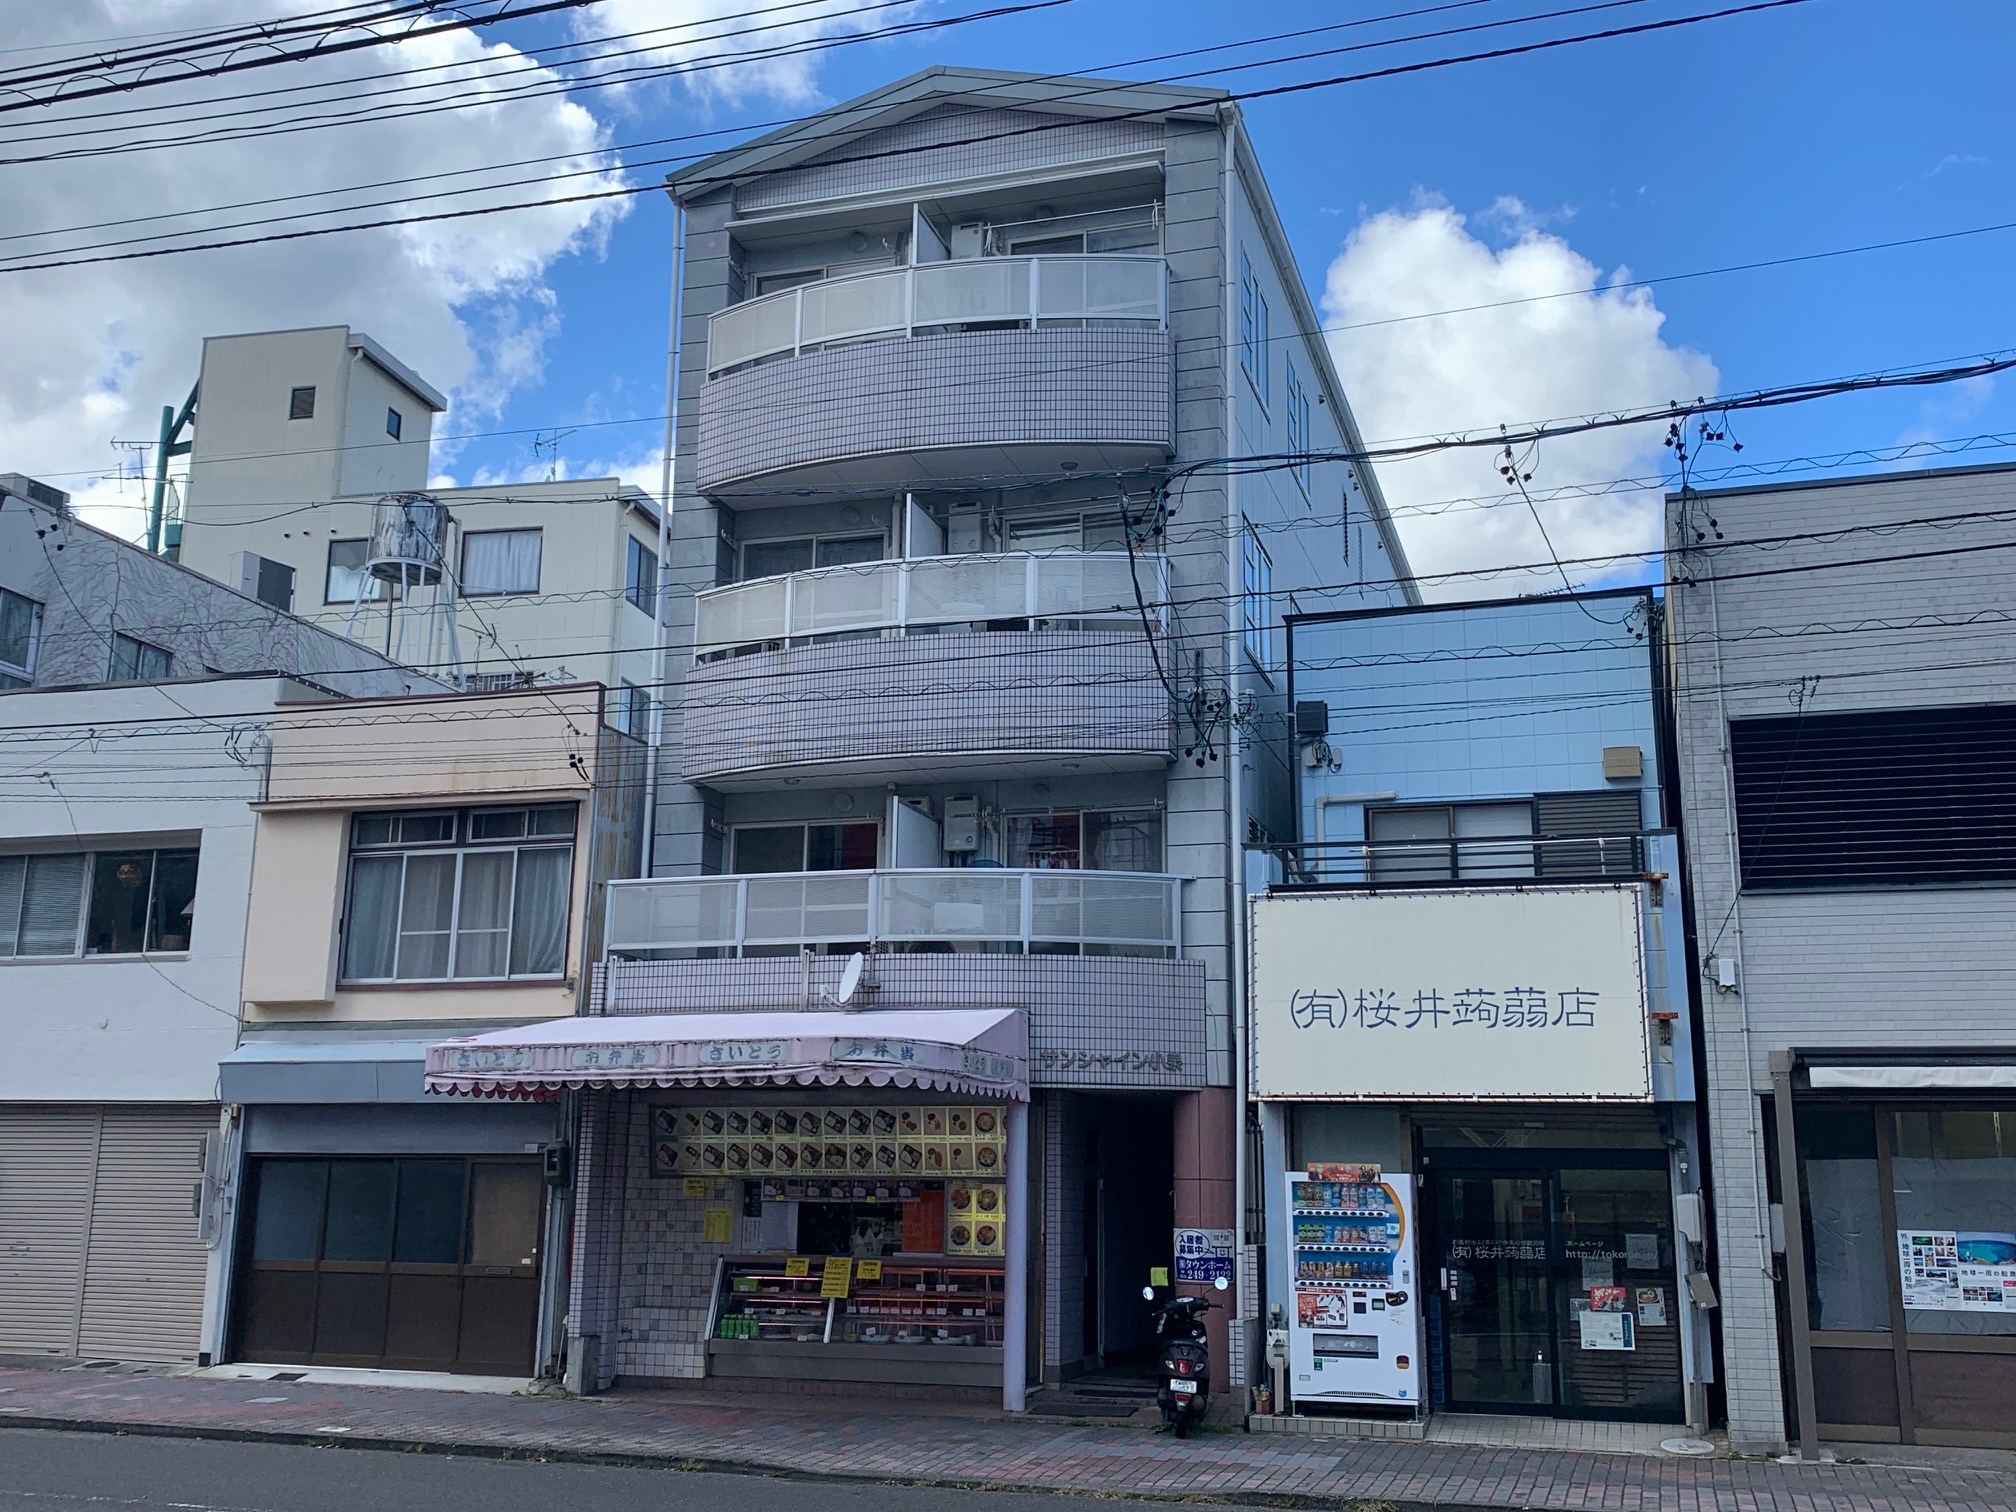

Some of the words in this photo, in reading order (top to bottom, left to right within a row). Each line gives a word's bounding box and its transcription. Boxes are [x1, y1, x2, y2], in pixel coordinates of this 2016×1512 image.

[1290, 986, 1600, 1029] (有)桜井蒟蒻店
[456, 1050, 523, 1067] さいとう
[585, 1049, 646, 1065] お弁当
[709, 1045, 781, 1060] さいとう
[847, 1042, 914, 1061] お弁当
[1041, 1050, 1184, 1072] サンシャイン小泉
[1179, 1235, 1203, 1245] 入居者
[1179, 1245, 1203, 1255] 募集中
